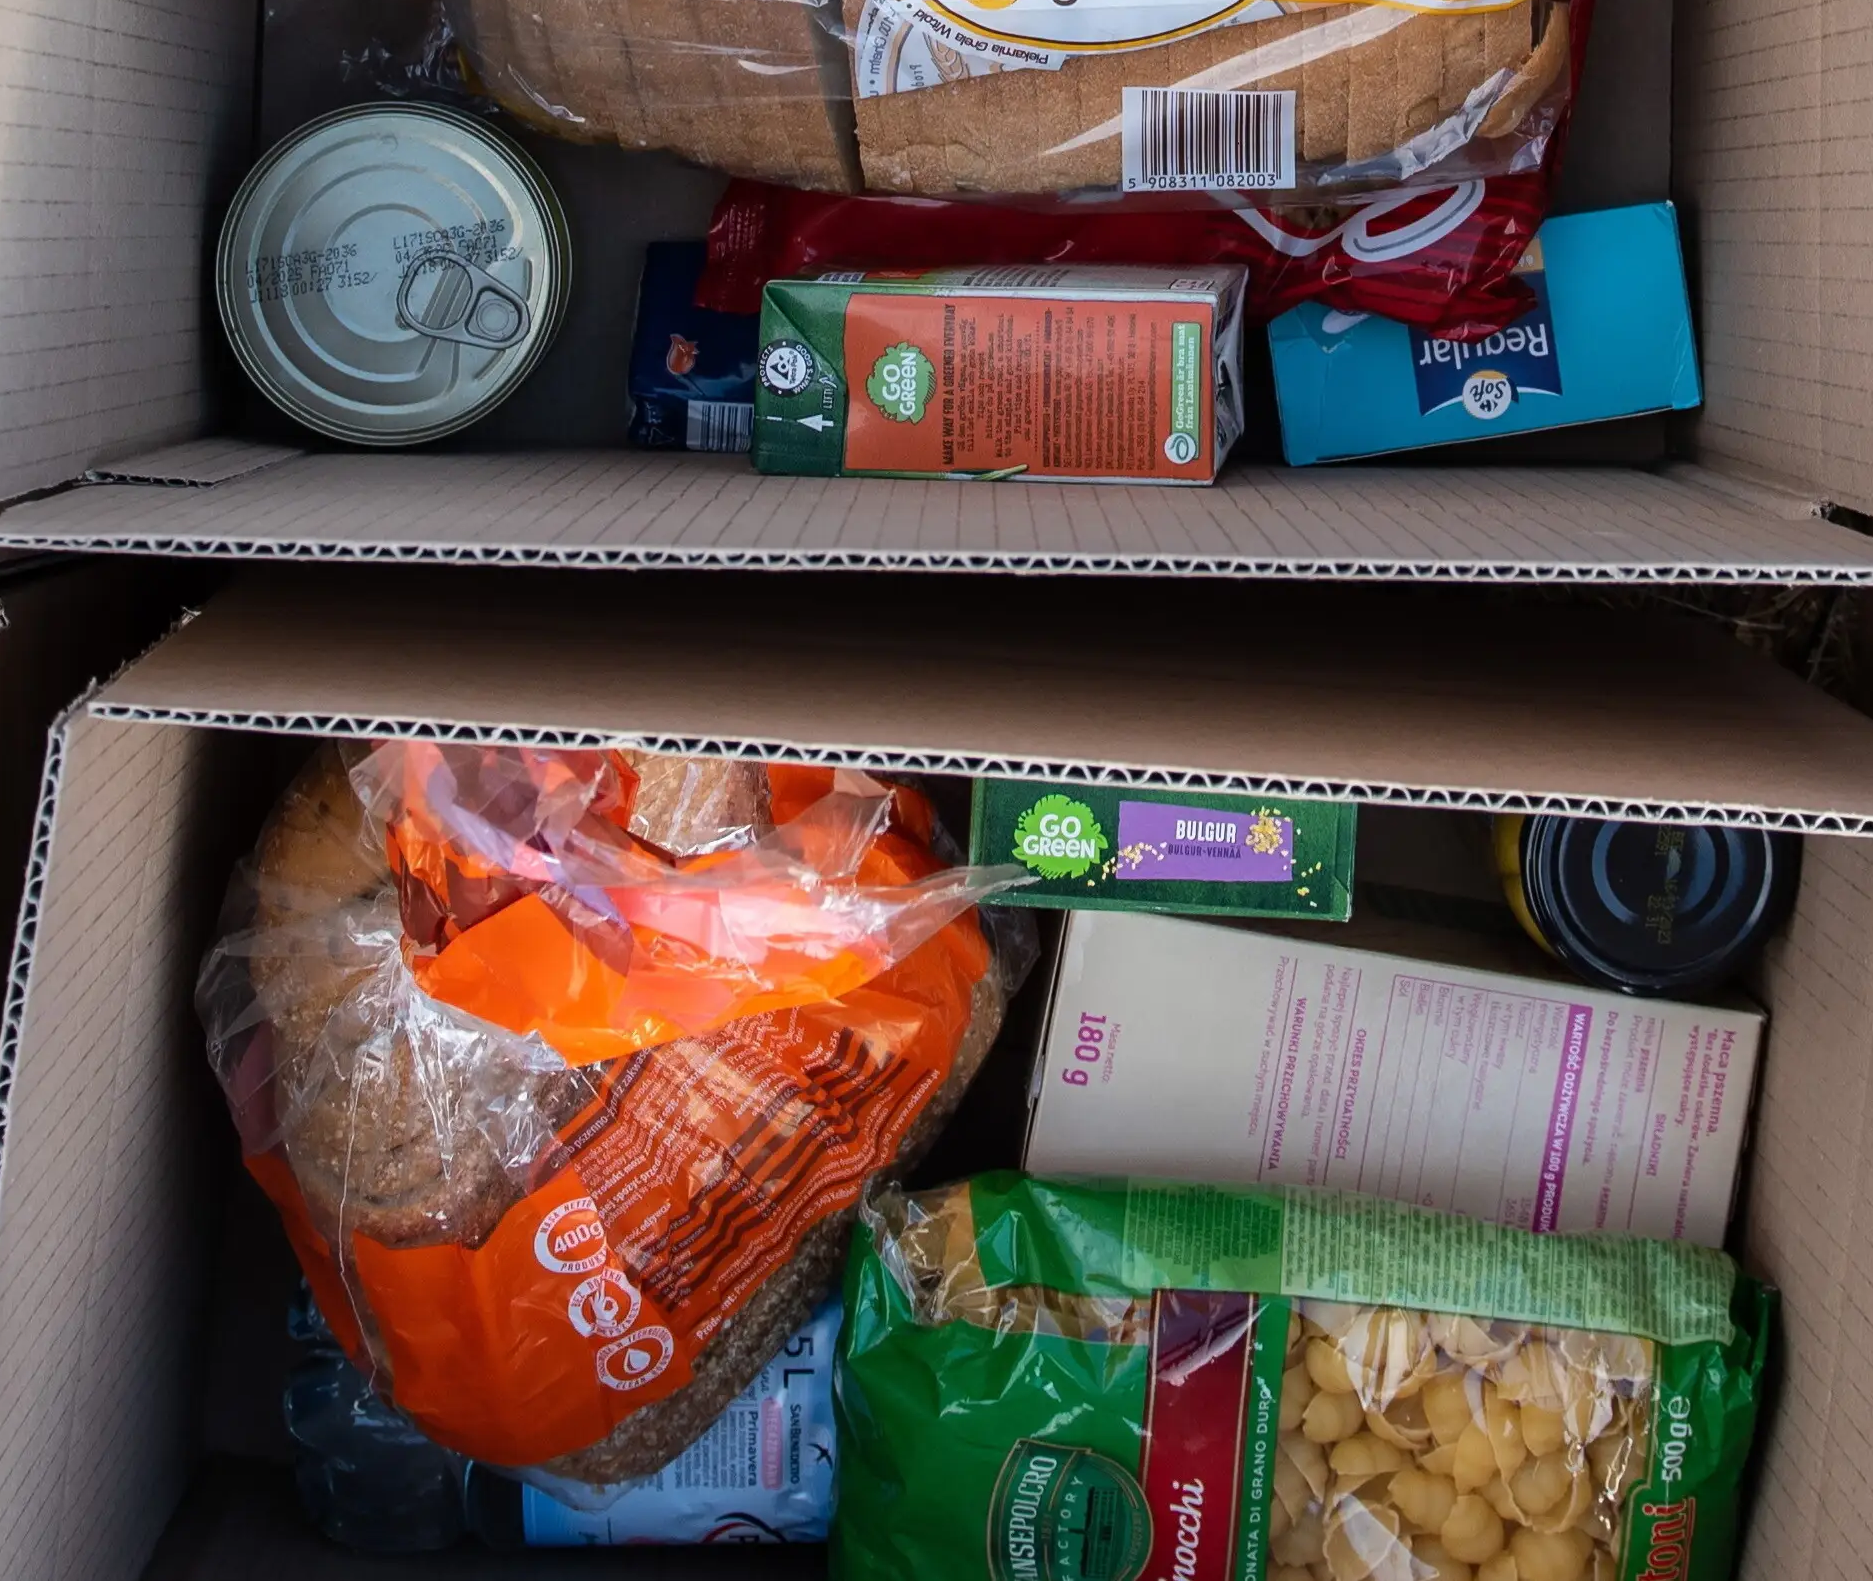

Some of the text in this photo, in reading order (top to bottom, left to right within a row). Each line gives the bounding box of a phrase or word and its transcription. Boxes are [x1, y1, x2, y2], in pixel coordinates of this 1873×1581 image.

[953, 32, 989, 50] Grela
[1004, 44, 1051, 66] Piekarnia
[1127, 172, 1278, 191] 5 908311 082003
[795, 343, 812, 366] GOOD
[1175, 324, 1184, 428] GoGreen är bra mat
[881, 364, 900, 400] GO
[943, 397, 955, 414] FOR
[1185, 336, 1194, 428] från Lantmännen
[943, 416, 955, 437] WAY
[1038, 814, 1082, 840] GO
[1167, 843, 1243, 860] BULGUR-VEHNÄÄ
[1174, 819, 1237, 844] BULGUR
[1060, 1010, 1106, 1088] 180 g
[1106, 1021, 1122, 1051] Masa
[1263, 996, 1308, 1172] WARUNKI PRZECHOWYWANIA
[1331, 1027, 1368, 1161] OKRES PRZYDATNOŚCI
[1546, 1011, 1589, 1173] WARTOŚĆ ODŻYWCZA 100
[1701, 1029, 1736, 1139] Maca pszenna.
[1643, 1112, 1667, 1178] SKŁADNIKI
[552, 1216, 605, 1256] 400g
[747, 1410, 759, 1487] Primavera
[1249, 1389, 1272, 1523] DI GRANO DURO
[1005, 1452, 1056, 1581] ANSEPOLCRO
[1162, 1476, 1205, 1581] nocchi
